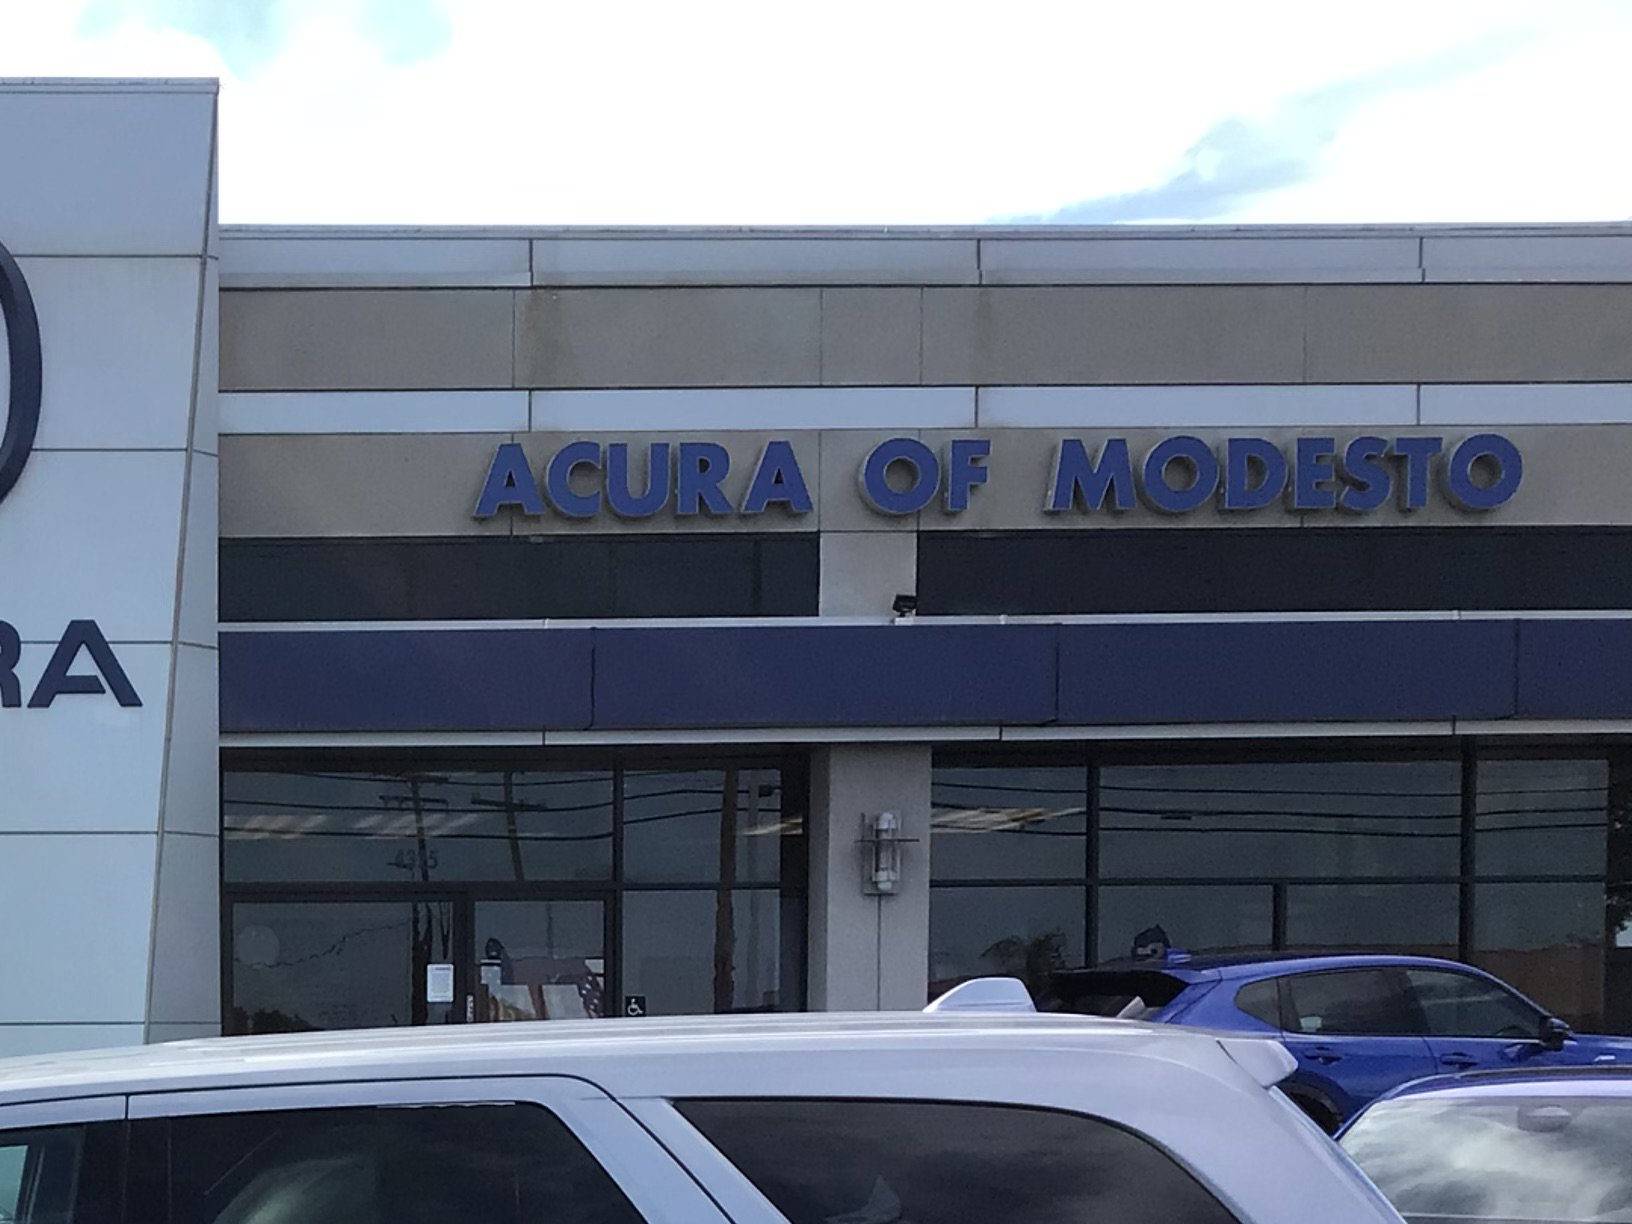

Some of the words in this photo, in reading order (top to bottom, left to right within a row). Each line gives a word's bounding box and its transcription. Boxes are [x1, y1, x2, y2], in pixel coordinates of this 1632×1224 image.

[473, 438, 814, 518] ACURA
[859, 437, 992, 515] OF
[1048, 433, 1523, 512] MODESTO
